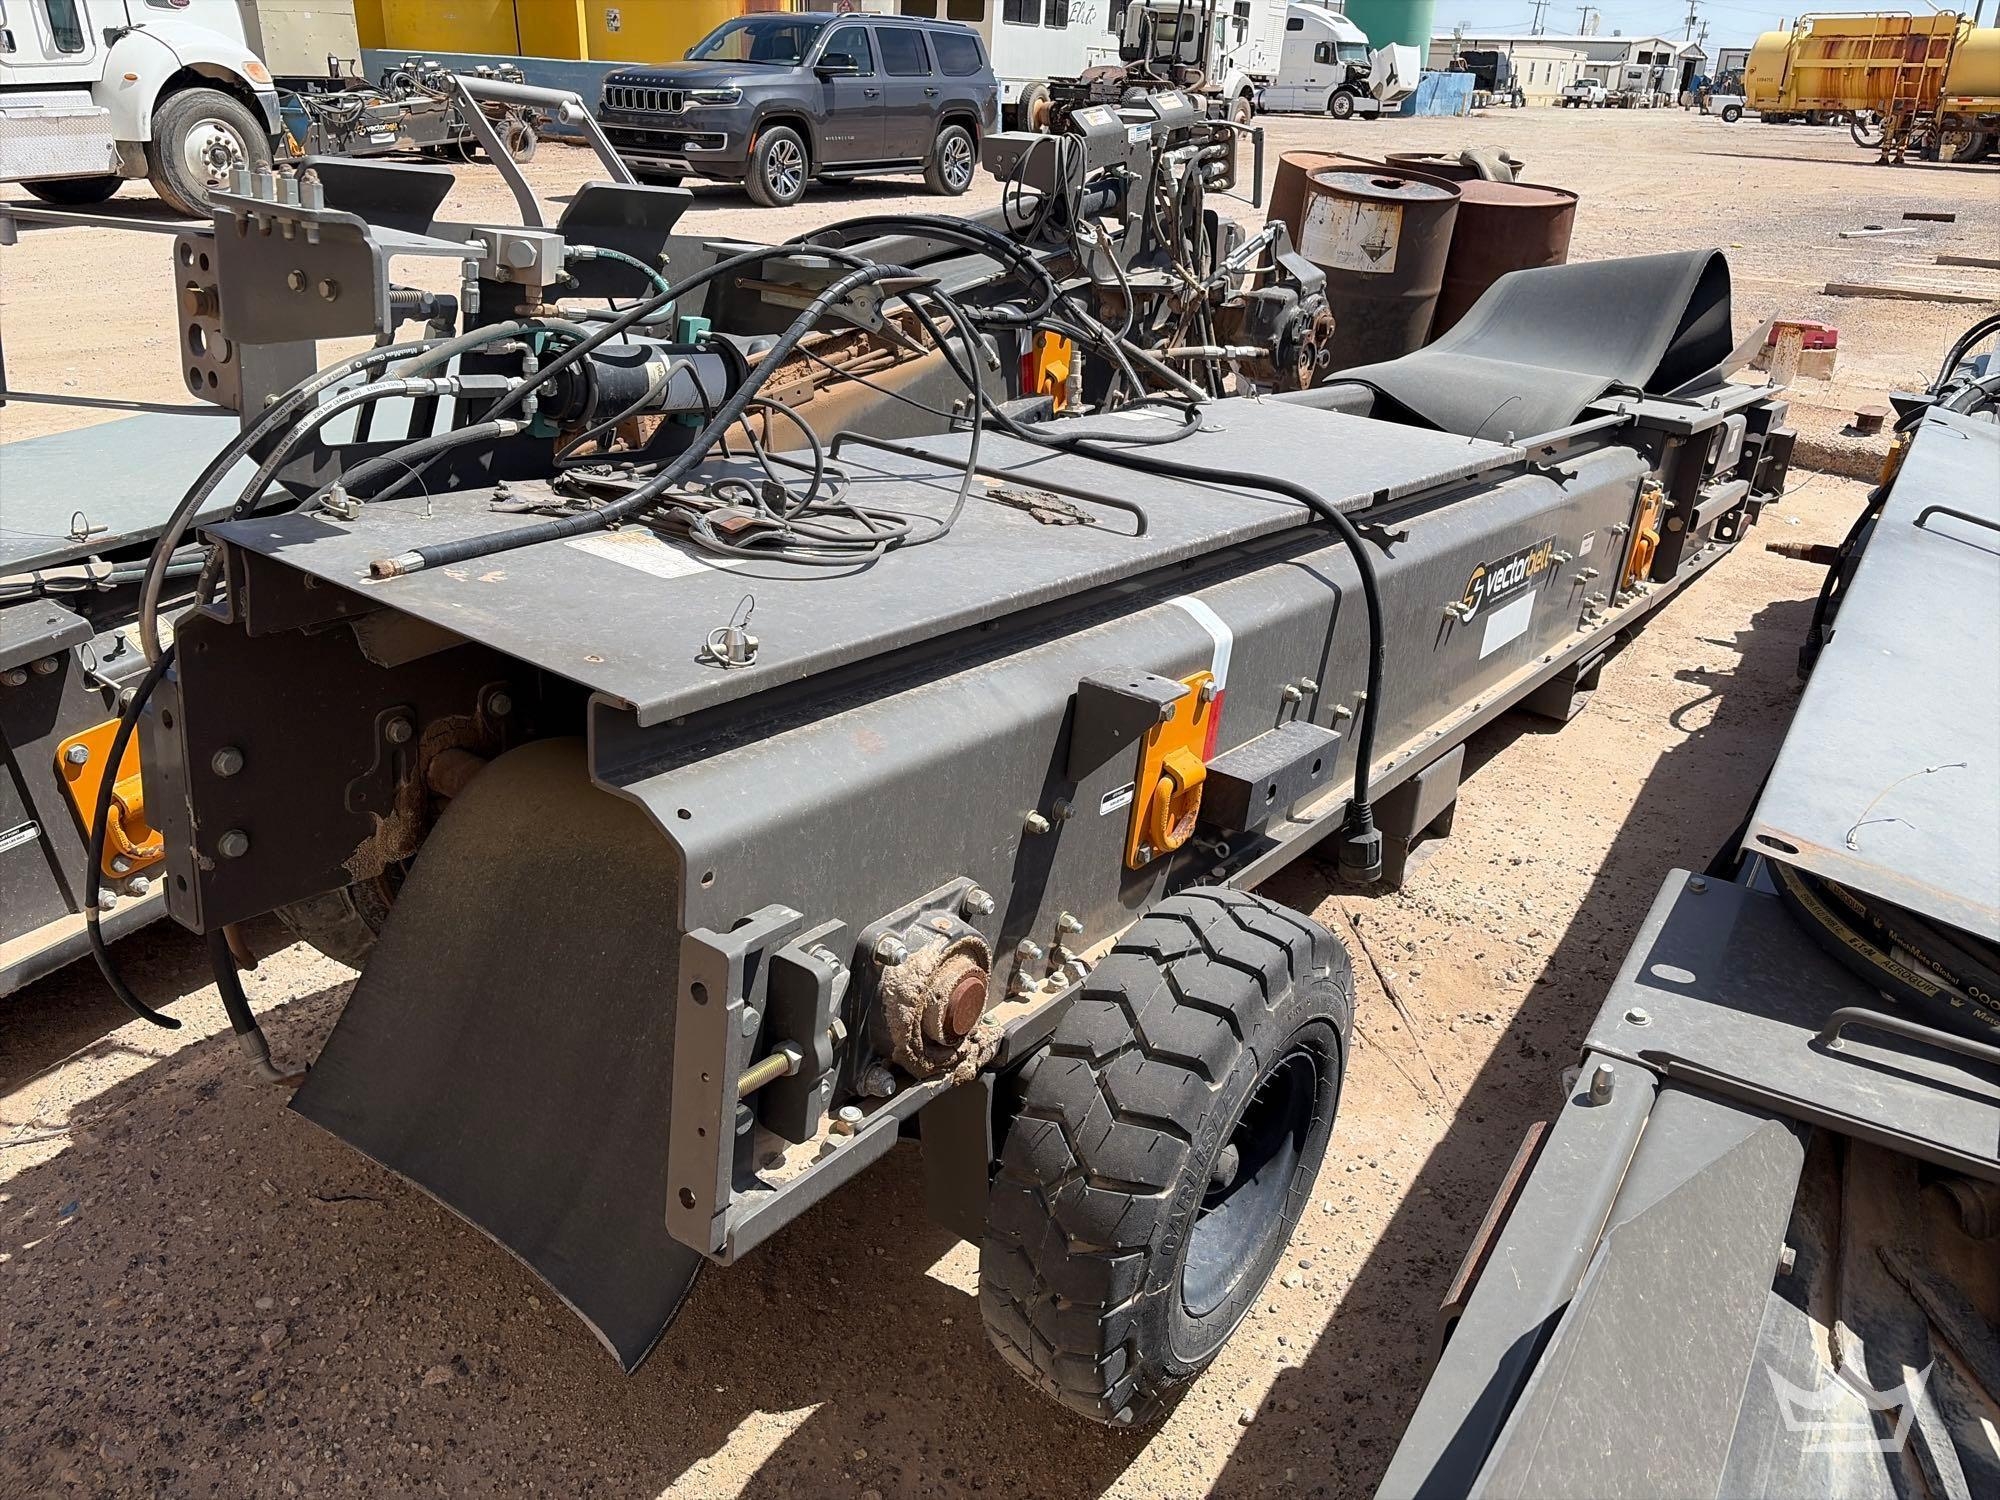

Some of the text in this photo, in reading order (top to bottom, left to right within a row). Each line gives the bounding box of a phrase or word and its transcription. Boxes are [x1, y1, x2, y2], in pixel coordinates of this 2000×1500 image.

[1485, 540, 1553, 597] vectorbelt
[1880, 959, 1938, 993] AEROQUIP
[1888, 929, 1931, 966] MatchMate
[1931, 960, 1960, 985] Global
[1160, 1093, 1238, 1256] CARLISLE
